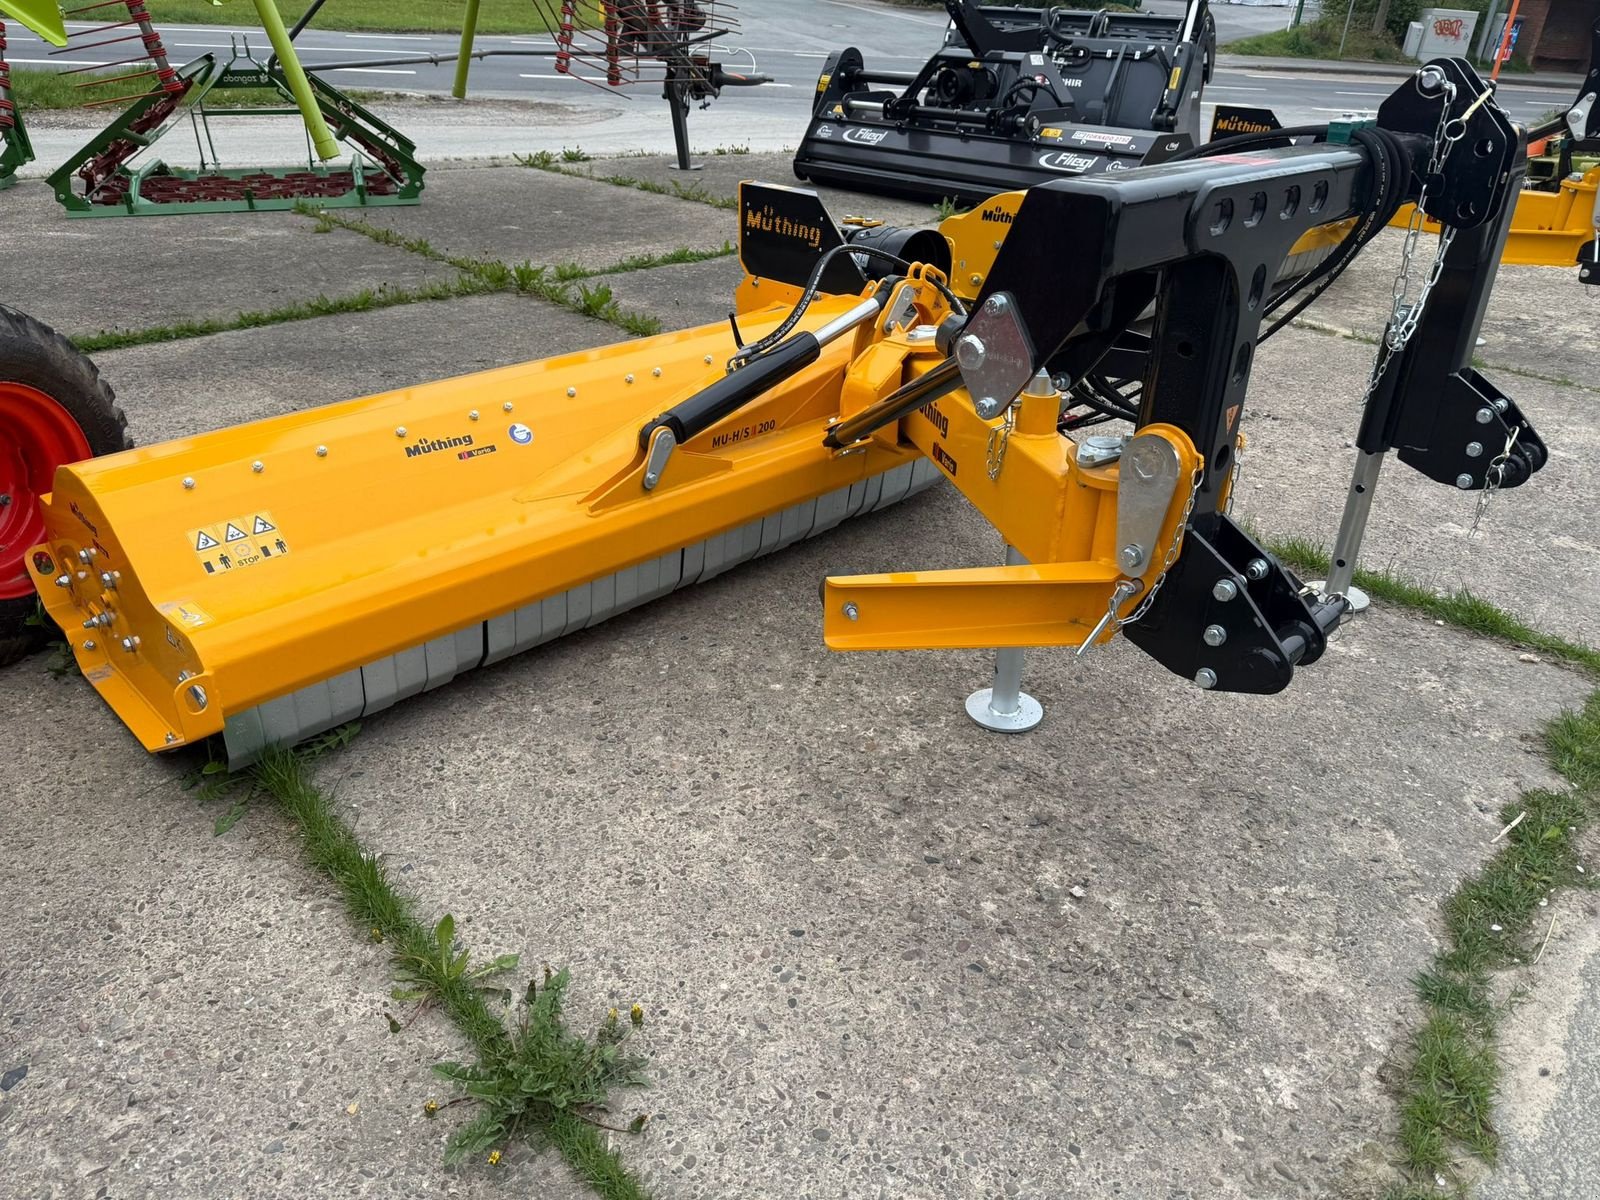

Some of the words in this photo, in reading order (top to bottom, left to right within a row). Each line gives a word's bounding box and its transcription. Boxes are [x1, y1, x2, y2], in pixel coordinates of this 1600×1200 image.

[854, 128, 888, 143] Fliegl
[1054, 152, 1099, 172] Fliegl
[746, 204, 821, 246] Müthing
[711, 426, 750, 448] MU-H/S
[757, 419, 776, 434] 200
[404, 434, 474, 458] Müthing
[472, 447, 491, 456] Vario
[237, 555, 260, 567] STOP
